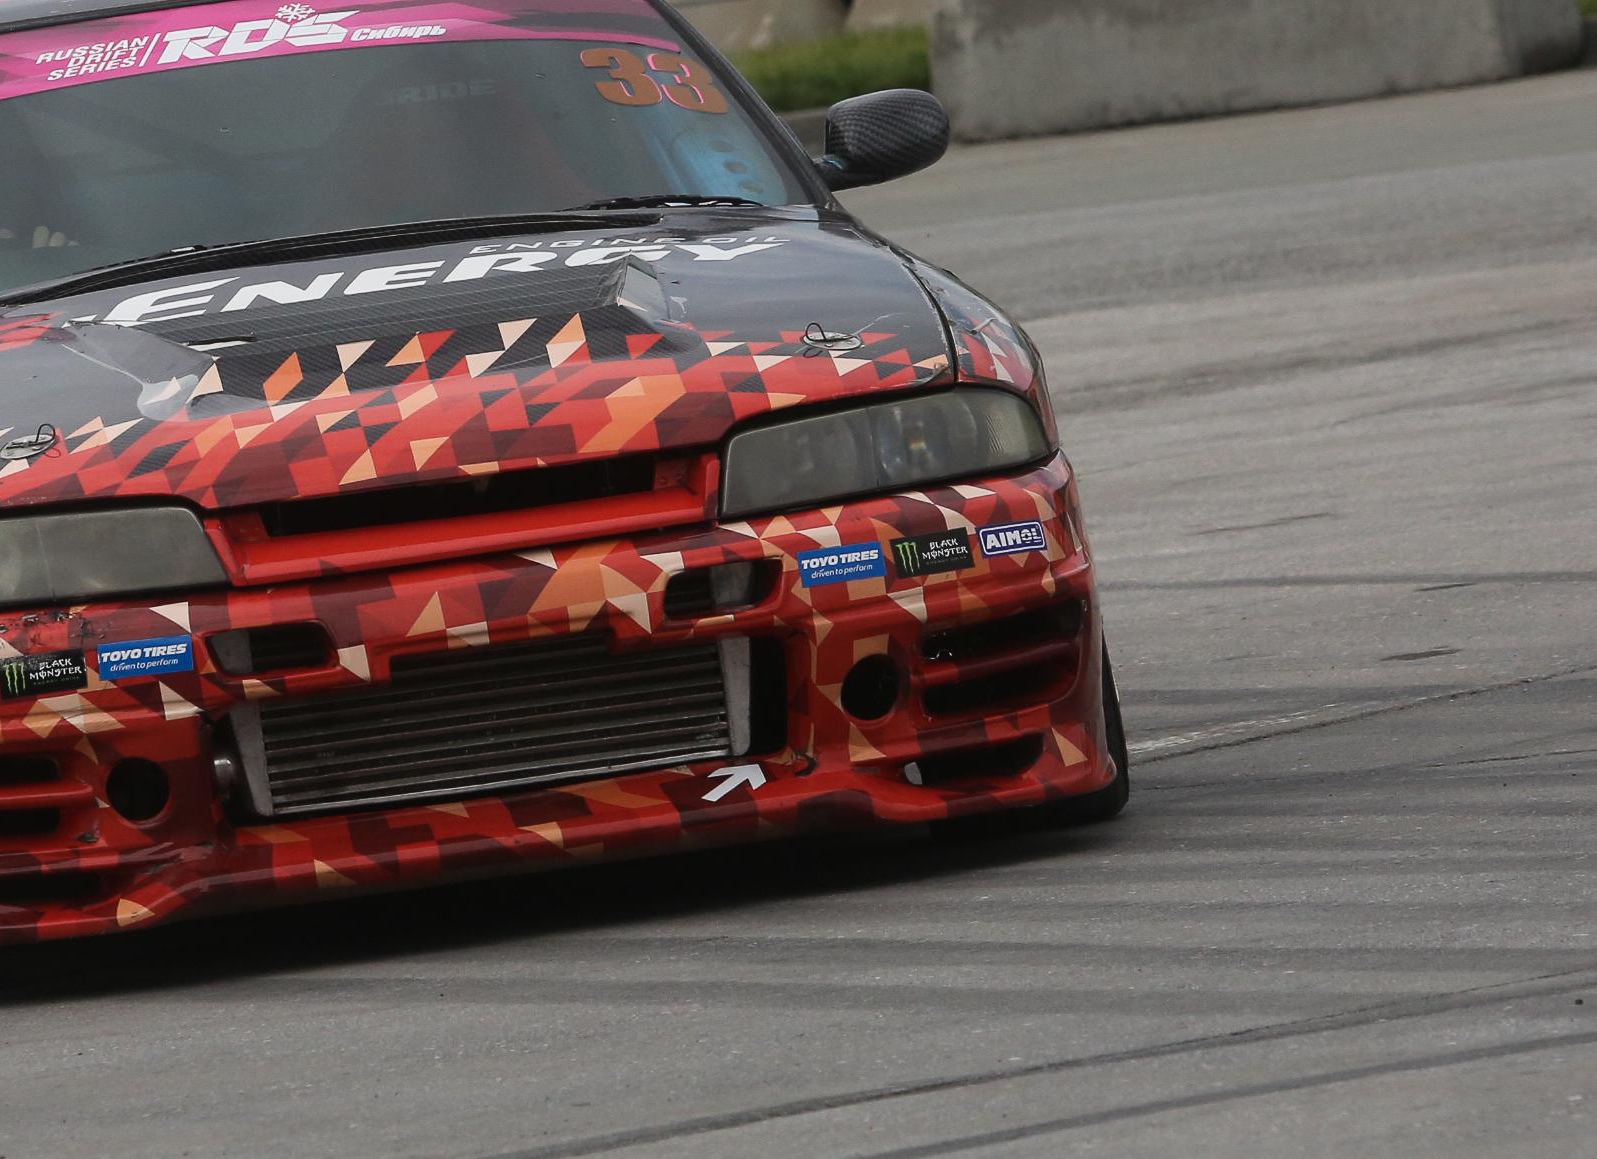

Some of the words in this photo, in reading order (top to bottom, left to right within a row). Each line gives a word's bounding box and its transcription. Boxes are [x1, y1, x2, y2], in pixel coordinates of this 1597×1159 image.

[157, 10, 360, 65] RDS
[351, 25, 447, 42] Сибирь
[36, 36, 149, 65] RUSSIAN
[66, 48, 142, 69] DRIFT
[47, 56, 136, 81] SERIES
[580, 48, 729, 114] 33
[469, 237, 686, 254] ENGINE
[702, 236, 791, 244] OIL
[102, 242, 785, 328] ENERGY
[929, 538, 959, 550] BLACK
[986, 528, 1042, 549] AIMOL
[801, 555, 839, 569] TOYO
[839, 549, 879, 564] TIRES
[922, 545, 969, 560] MONSTER
[811, 568, 835, 579] driven
[835, 566, 843, 575] to
[843, 563, 873, 575] perform
[102, 649, 142, 663] TOYO
[143, 643, 187, 657] TIRES
[29, 666, 83, 681] MONSTER
[39, 657, 73, 671] BLACK
[110, 660, 136, 672] driven
[136, 661, 146, 669] to
[146, 657, 179, 670] perform
